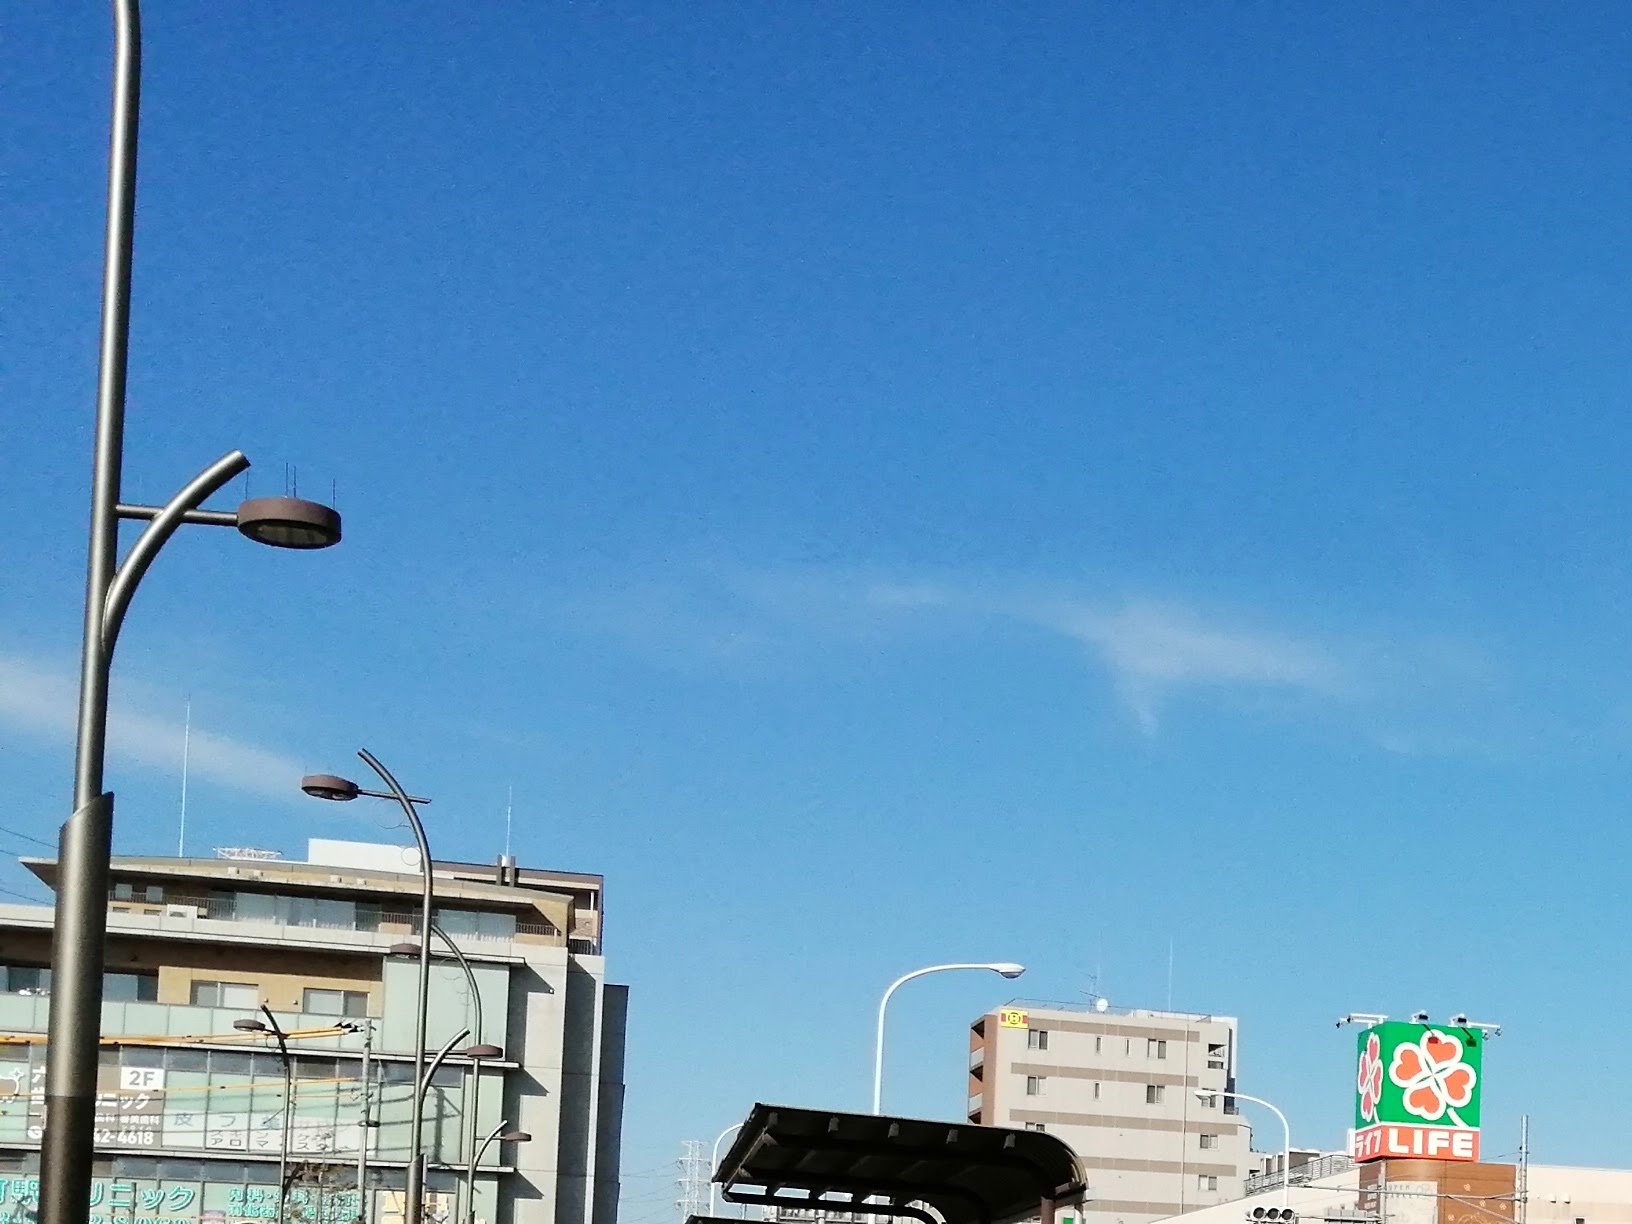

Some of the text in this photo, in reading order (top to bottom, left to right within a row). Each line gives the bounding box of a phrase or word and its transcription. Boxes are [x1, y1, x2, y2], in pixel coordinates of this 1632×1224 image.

[129, 1070, 155, 1087] 2F
[1355, 1130, 1382, 1158] ライフ
[1388, 1128, 1474, 1158] LIFE
